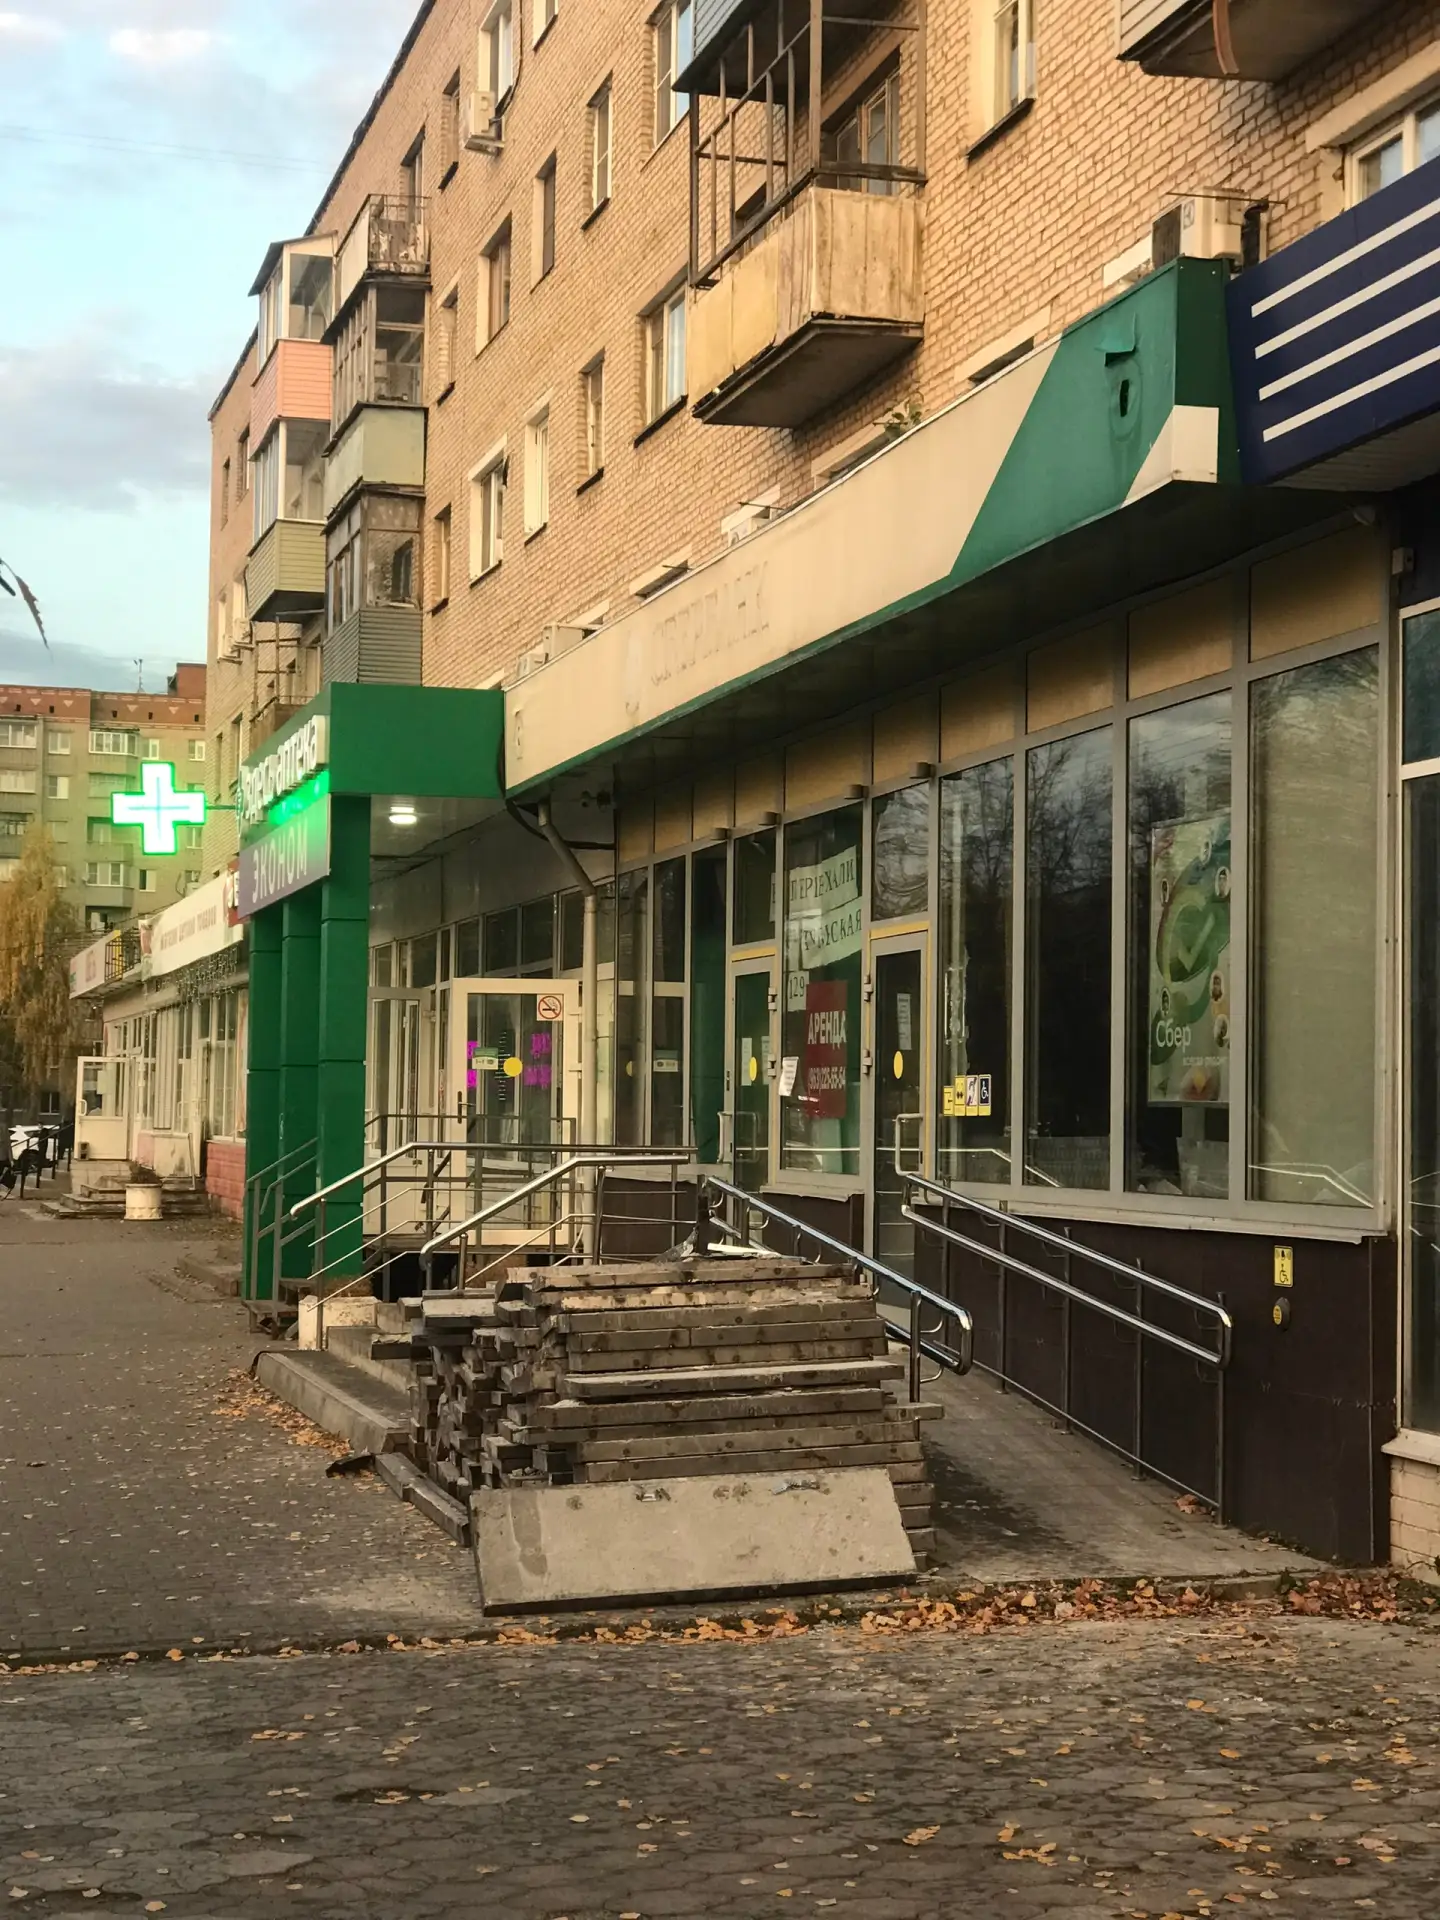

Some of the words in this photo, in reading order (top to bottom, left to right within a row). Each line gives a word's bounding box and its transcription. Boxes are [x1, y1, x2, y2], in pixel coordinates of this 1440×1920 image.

[788, 976, 805, 999] 129
[807, 1010, 847, 1050] АРЕНДА
[1156, 1018, 1191, 1053] Сбер
